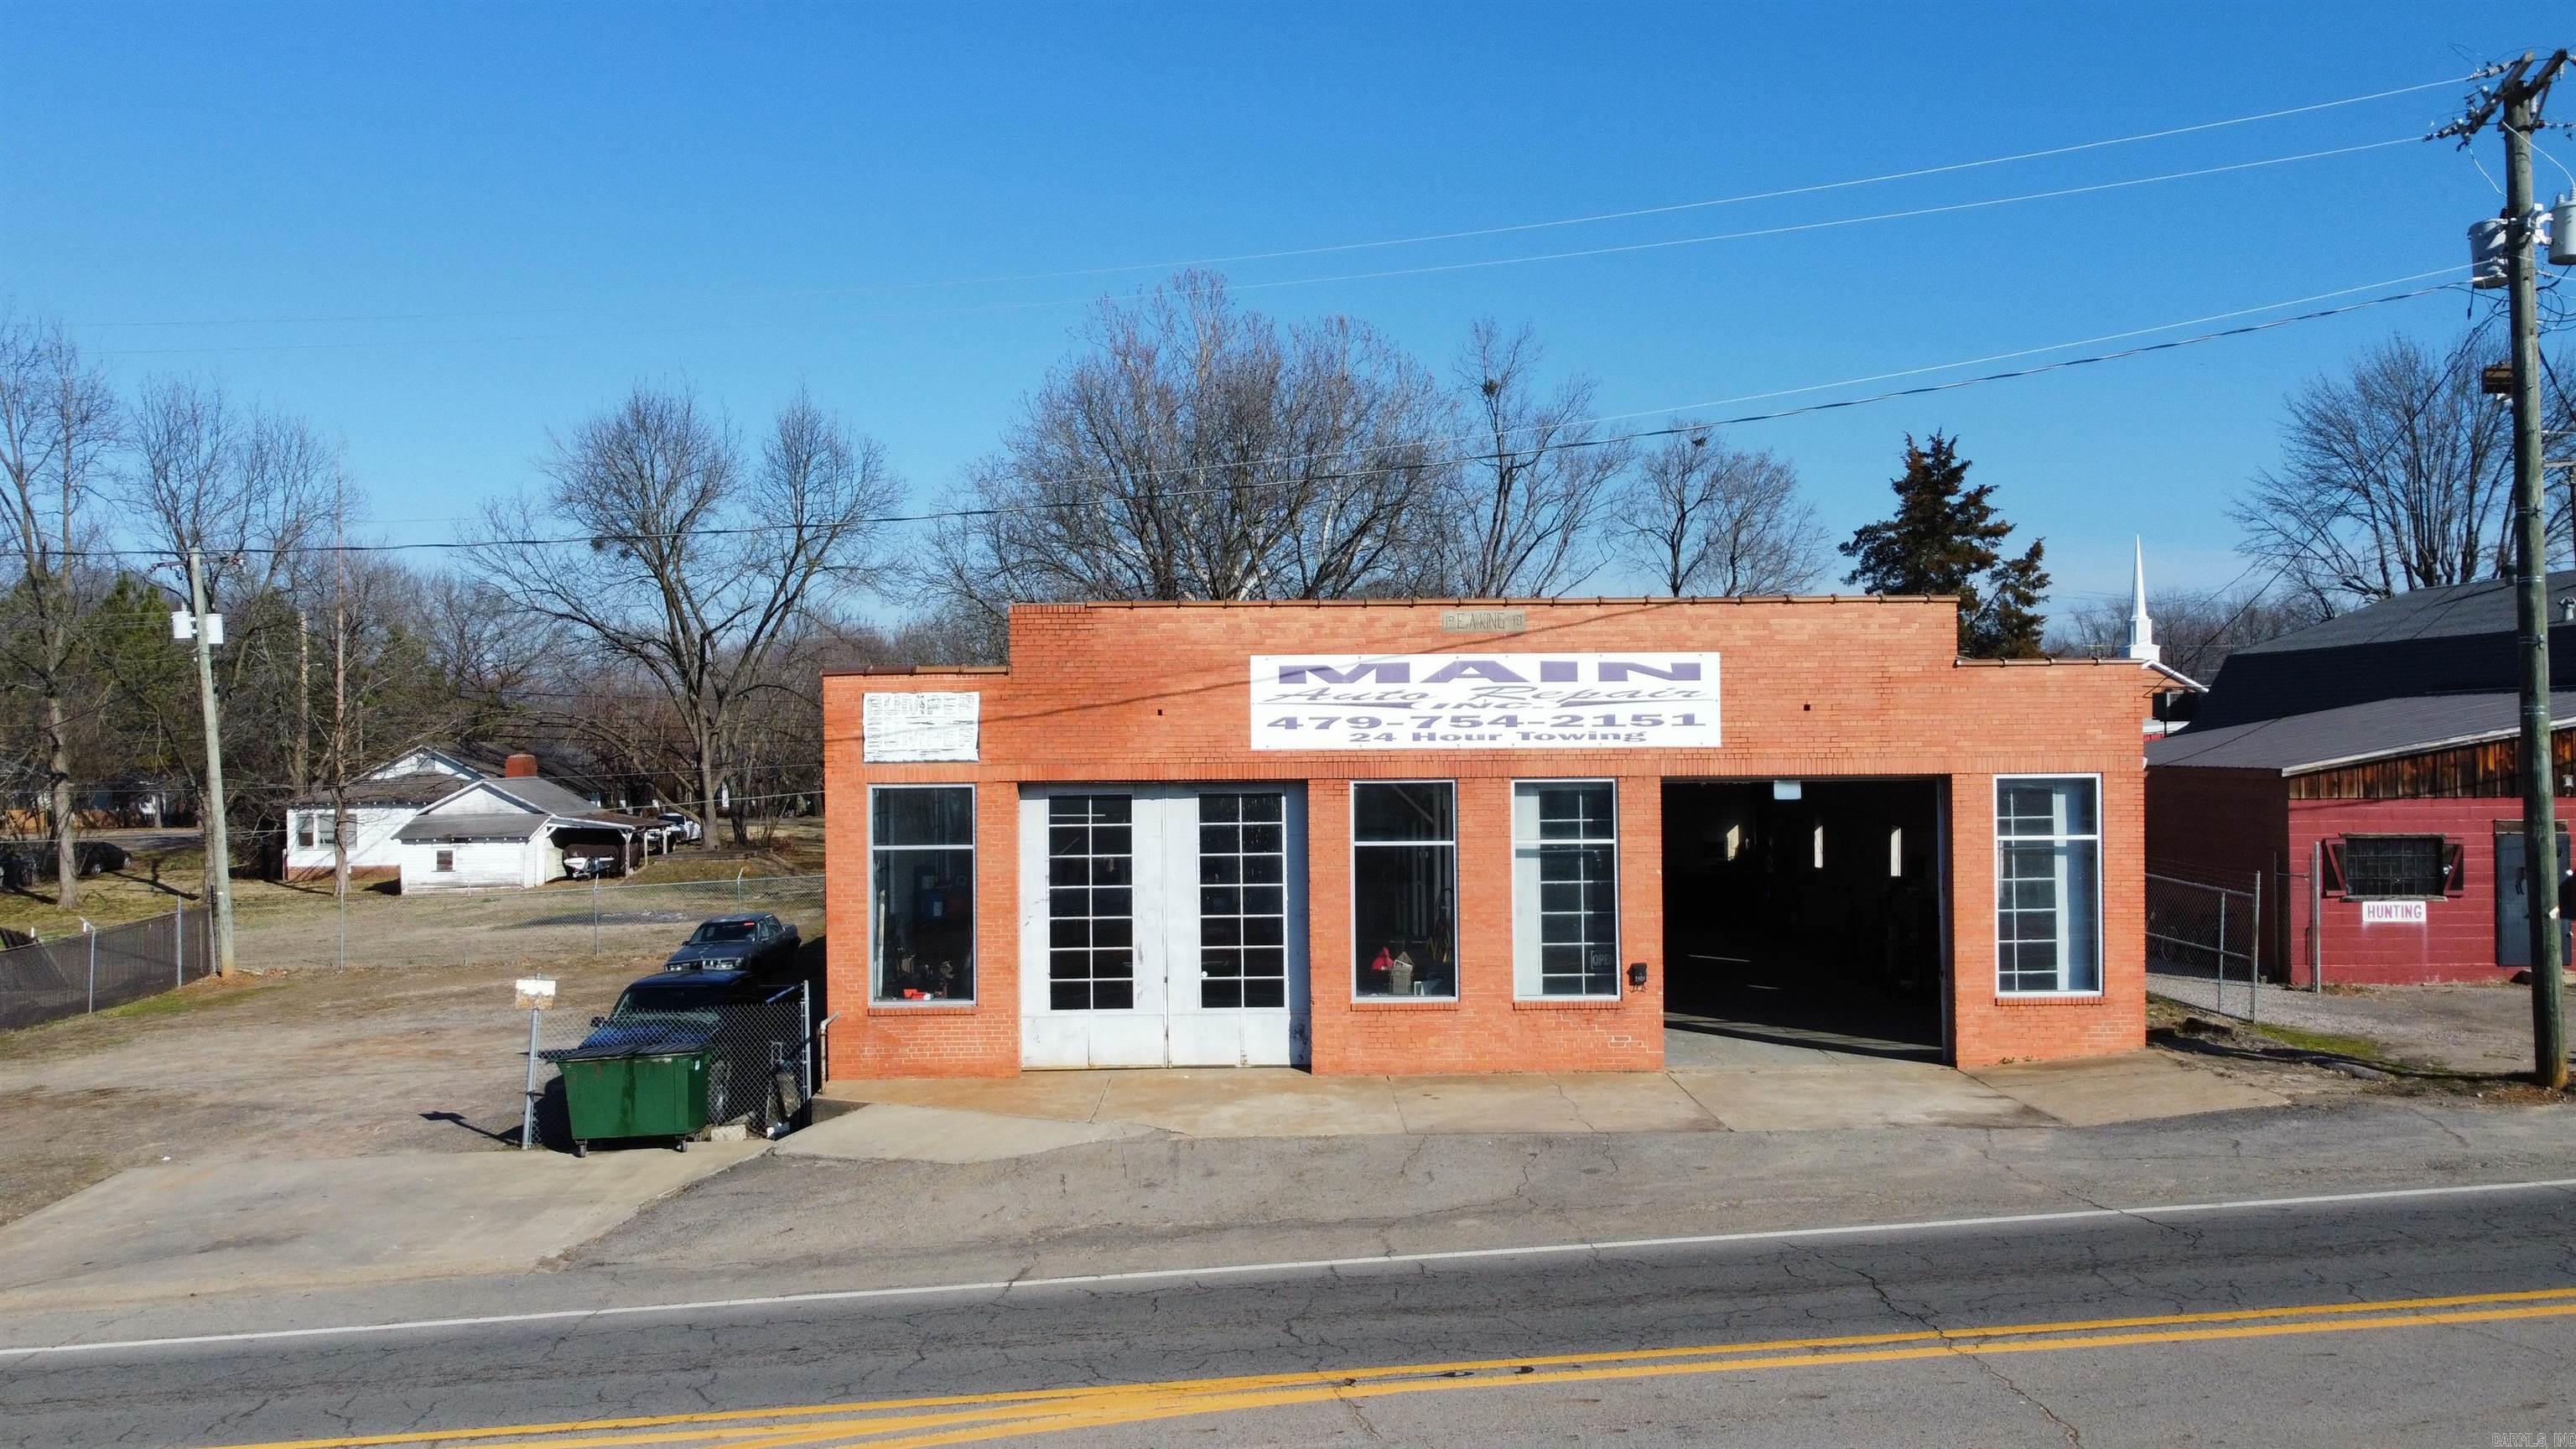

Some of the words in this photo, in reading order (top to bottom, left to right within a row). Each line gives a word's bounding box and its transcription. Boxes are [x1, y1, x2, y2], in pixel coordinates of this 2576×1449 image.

[1278, 660, 1701, 684] MAIN
[1264, 687, 1431, 702] Auto
[1467, 685, 1707, 704] Repair
[1267, 714, 1706, 730] 479-754-2151
[1349, 732, 1397, 742] 24
[1412, 731, 1503, 742] Hour
[1516, 731, 1648, 742] Towing
[2367, 905, 2423, 919] HUNTING
